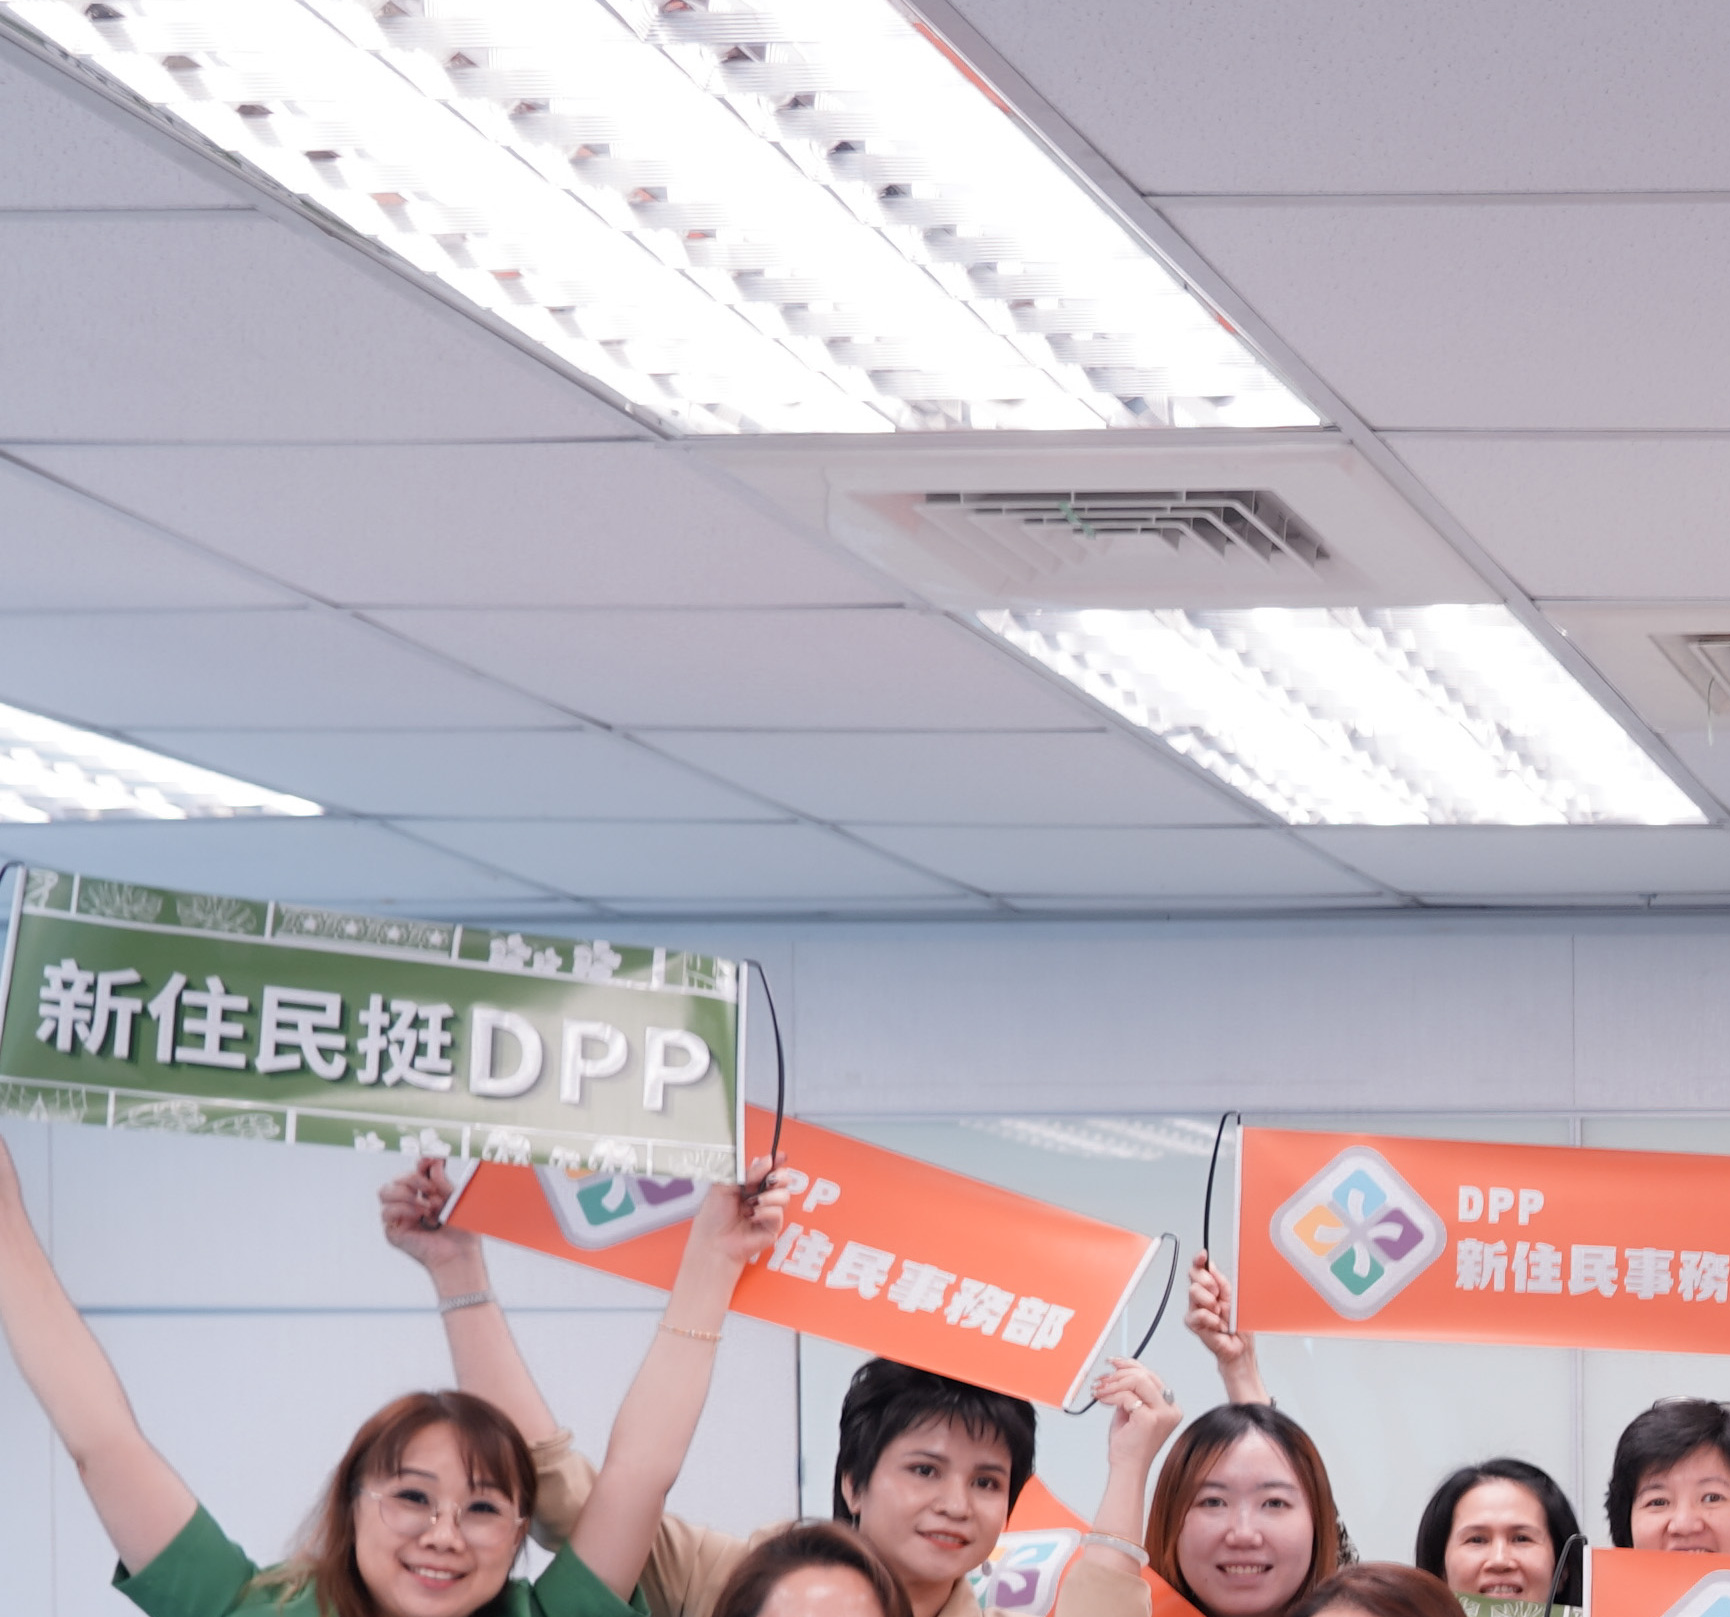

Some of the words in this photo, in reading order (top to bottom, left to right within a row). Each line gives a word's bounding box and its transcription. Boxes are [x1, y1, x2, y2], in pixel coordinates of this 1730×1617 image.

[35, 958, 712, 1112] 新住民挺DPP
[787, 1167, 841, 1212] PP
[1458, 1186, 1545, 1225] DPP
[750, 1222, 1075, 1352] 住民事務部
